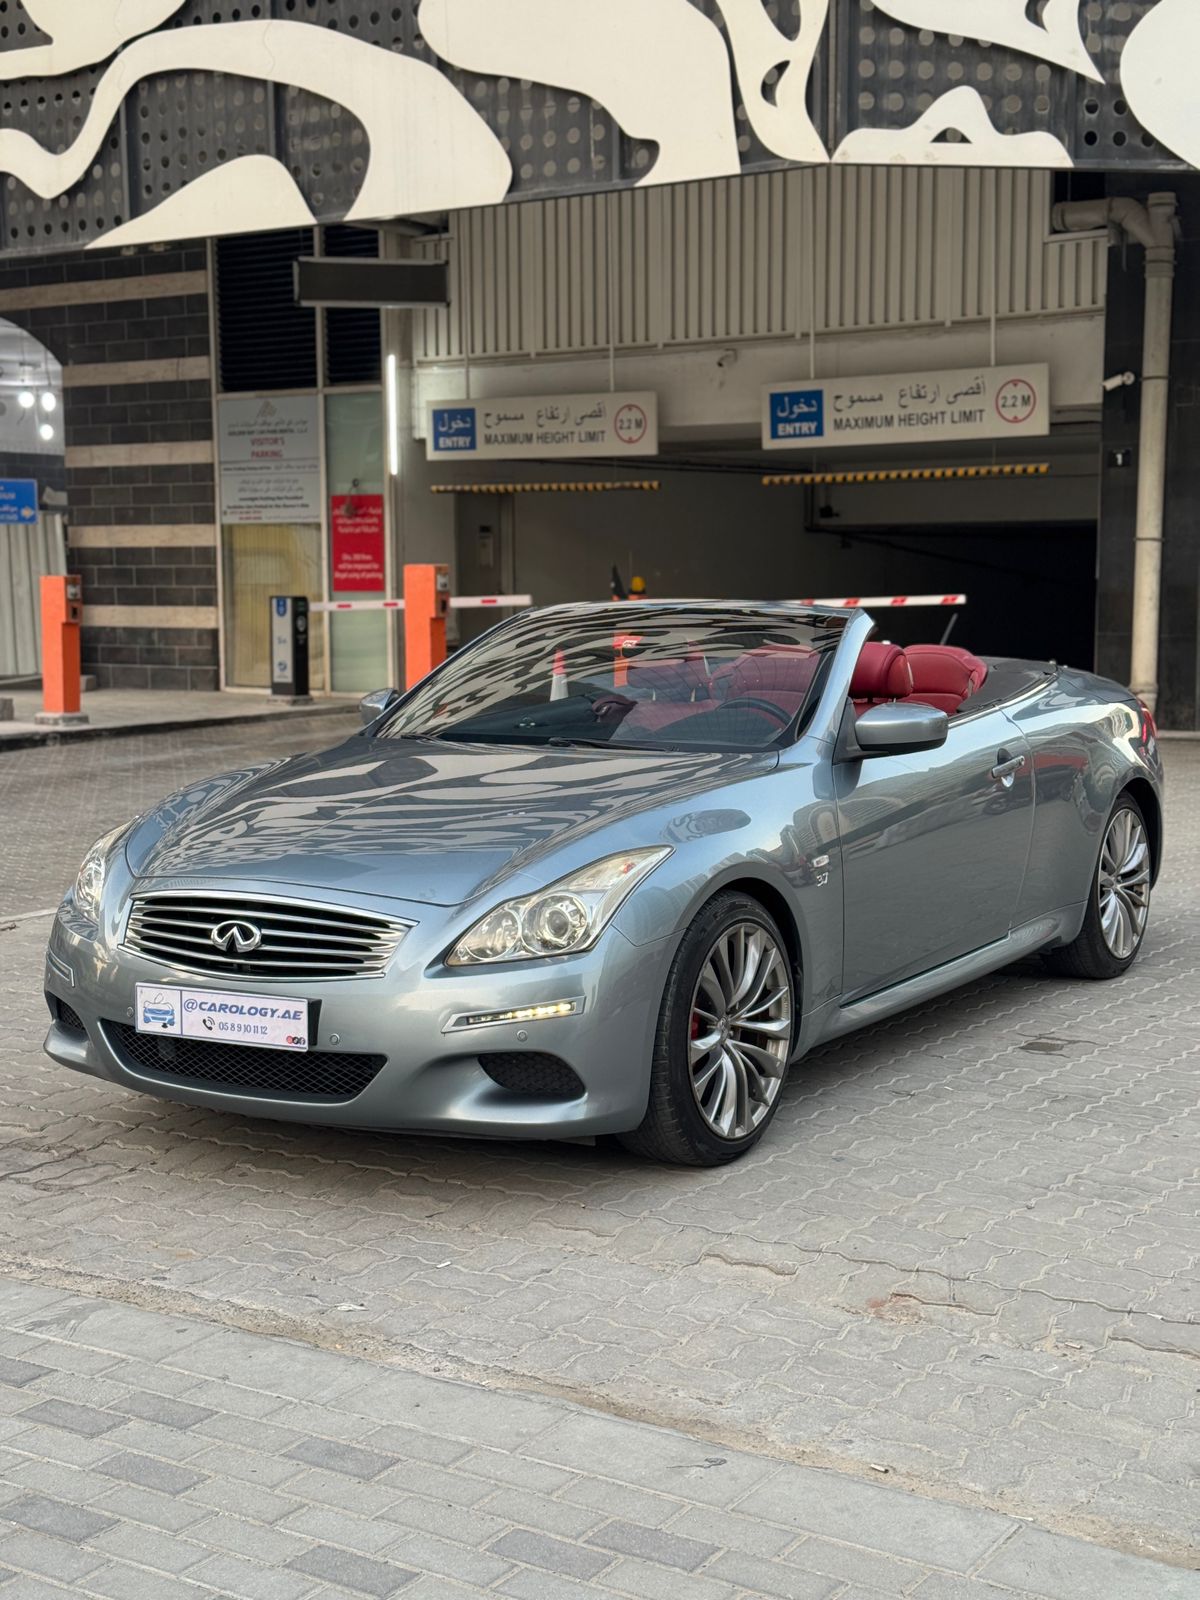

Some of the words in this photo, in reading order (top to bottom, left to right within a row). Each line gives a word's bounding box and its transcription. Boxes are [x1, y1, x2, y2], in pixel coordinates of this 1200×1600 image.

[833, 393, 884, 412] مسموح
[898, 384, 940, 409] ارتفاع
[1001, 395, 1018, 408] 2.2
[1021, 394, 1031, 407] M
[777, 396, 818, 419] دخول
[438, 412, 472, 433] دخول
[484, 412, 524, 429] مسموح
[536, 405, 570, 429] ارتفاع
[619, 418, 632, 430] 2.2
[634, 417, 643, 429] M
[833, 415, 894, 431] MAXIMUM
[898, 411, 946, 427] HEIGHT
[950, 409, 986, 424] LIMIT
[484, 432, 533, 445] MAXIMUM
[536, 430, 576, 444] HEIGHT
[578, 430, 606, 443] LIMIT
[777, 422, 818, 436] ENTRY
[438, 435, 472, 448] ENTRY
[250, 448, 283, 458] PARKING
[816, 871, 829, 887] 37
[184, 998, 304, 1021] @CAROLOGY.AE
